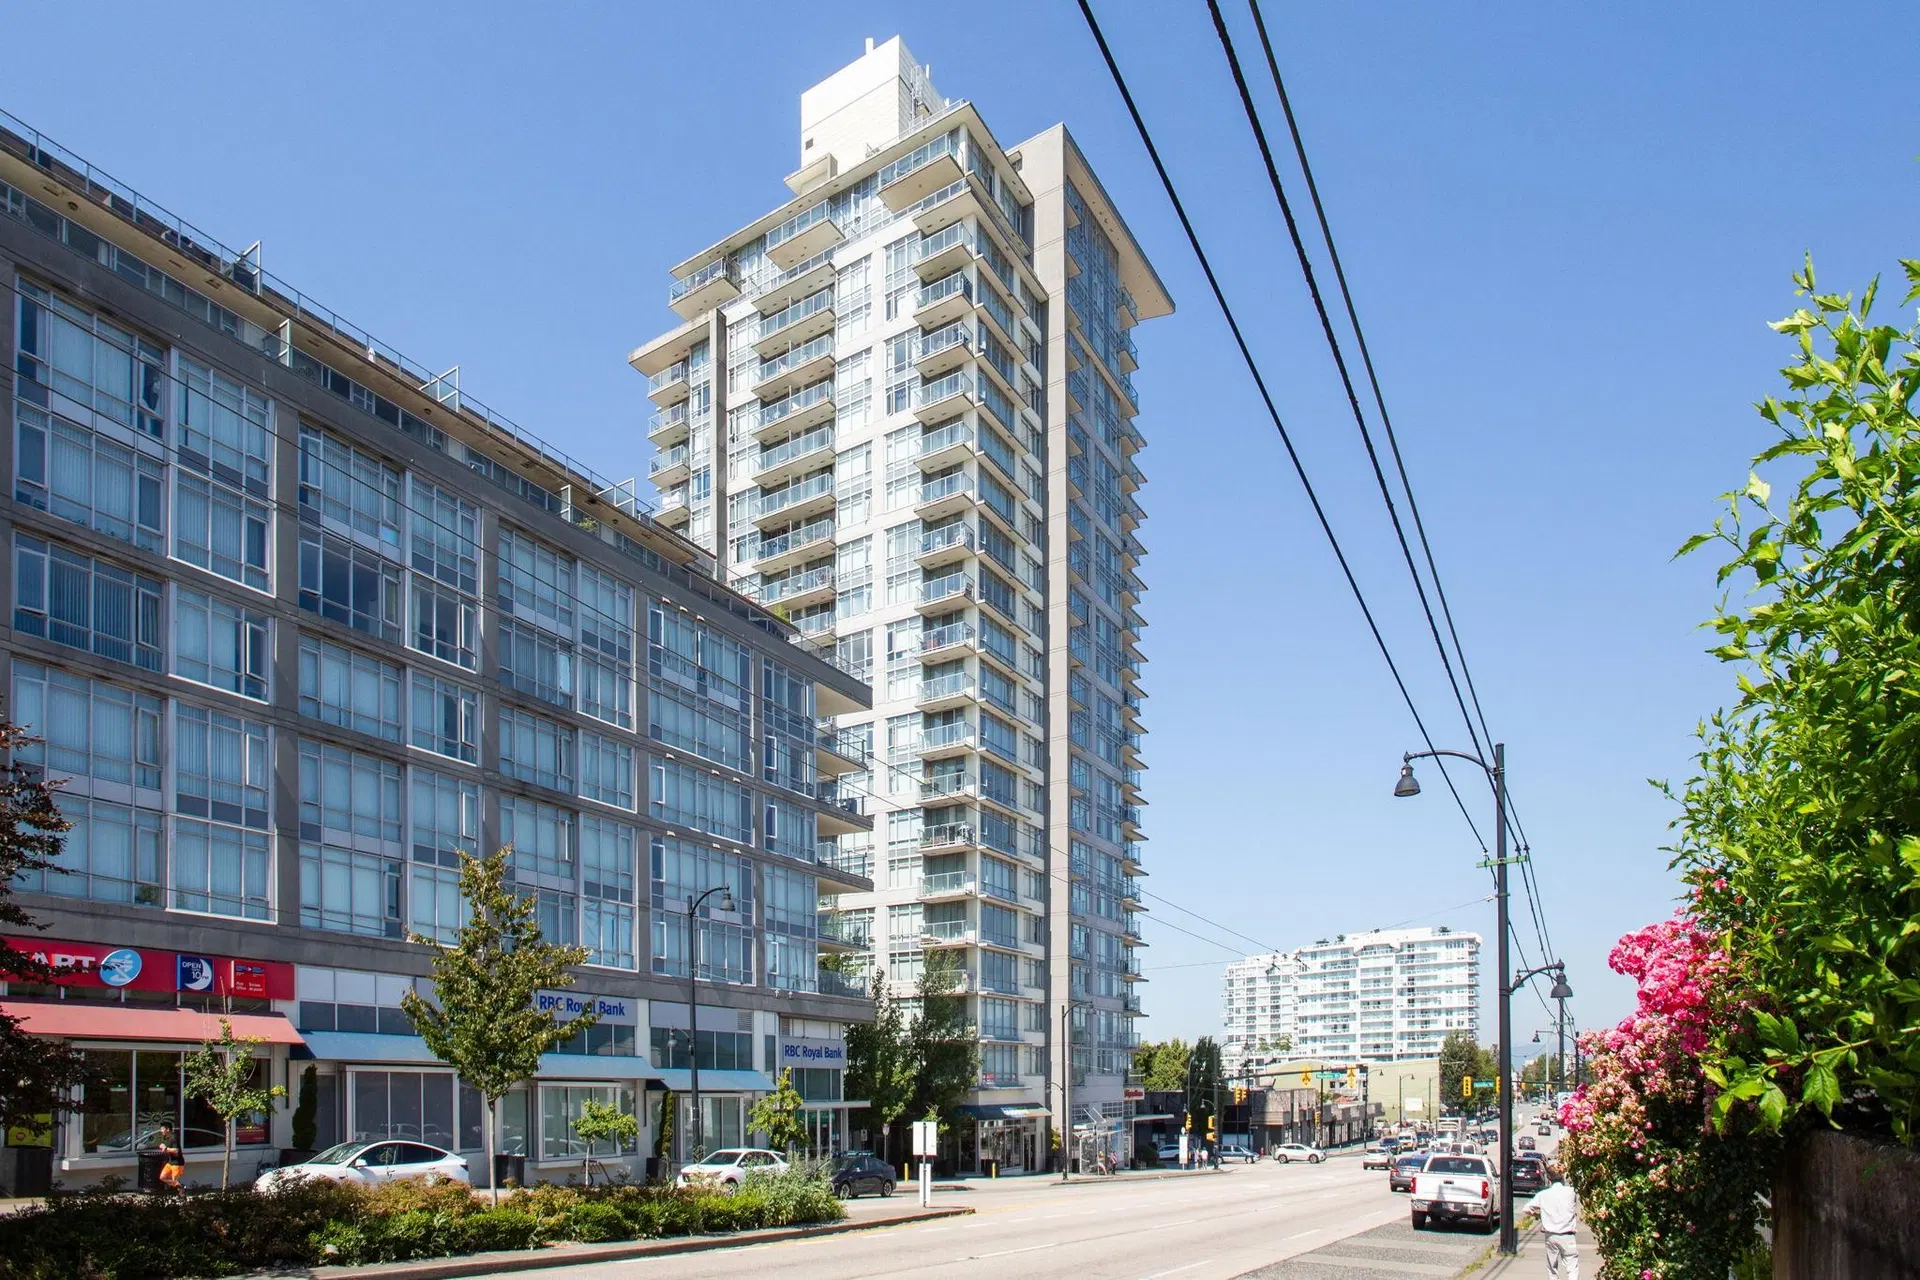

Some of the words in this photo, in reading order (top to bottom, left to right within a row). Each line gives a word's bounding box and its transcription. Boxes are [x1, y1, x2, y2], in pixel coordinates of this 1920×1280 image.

[182, 961, 201, 969] OPEN
[192, 971, 201, 979] 10
[599, 1001, 625, 1016] Bank
[784, 1044, 801, 1057] RBC
[802, 1045, 823, 1060] Royal
[824, 1045, 842, 1059] Bank
